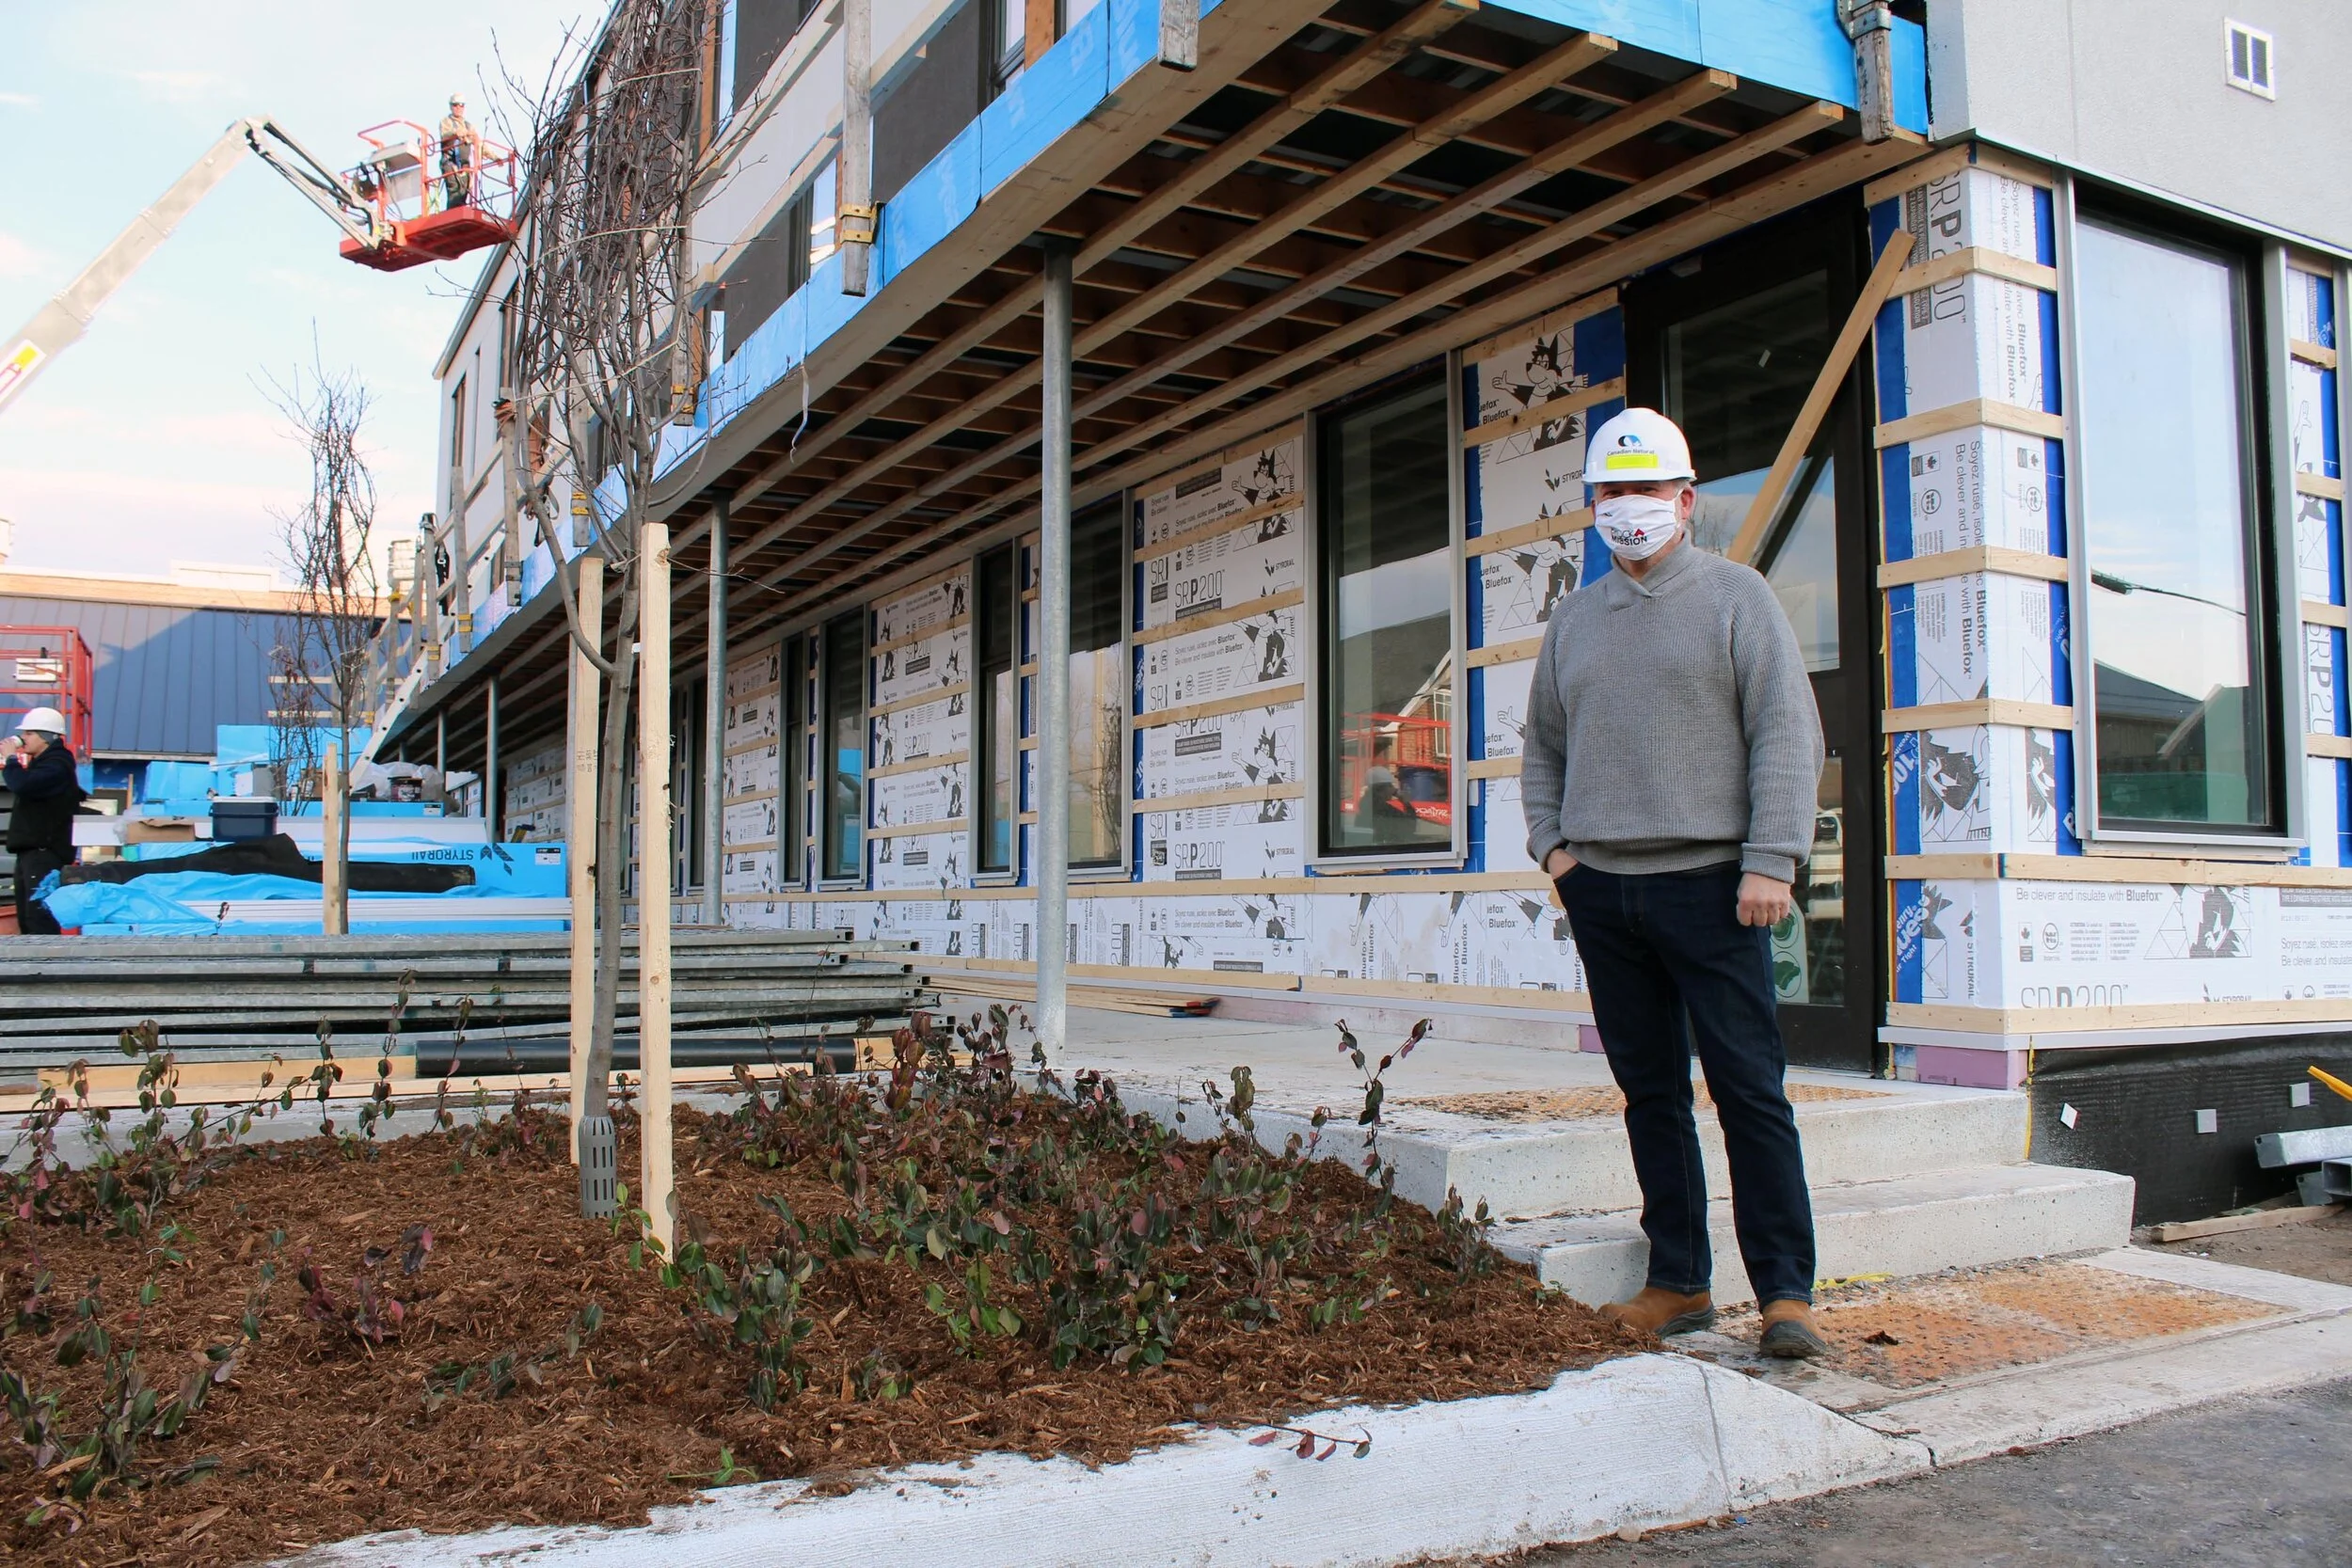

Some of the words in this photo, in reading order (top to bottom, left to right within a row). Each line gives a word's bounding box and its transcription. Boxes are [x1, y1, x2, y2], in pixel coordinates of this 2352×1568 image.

[2001, 193, 2010, 231] clever
[2006, 344, 2015, 398] Bluefox
[1955, 443, 1966, 463] Be
[1562, 469, 1582, 483] STYROR
[1957, 466, 1967, 502] clever
[1217, 499, 1235, 512] Bluefox
[1958, 508, 1970, 531] and
[1612, 534, 1647, 546] MISSION
[1968, 440, 1980, 480] Soyez
[1976, 590, 1987, 647] Bluefox
[1486, 576, 1512, 589] Bluefox
[1961, 587, 1972, 614] with
[1217, 634, 1235, 644] Bluefox
[1225, 643, 1243, 654] Bluefox
[1962, 618, 1974, 674] Bluefox
[1487, 746, 1515, 757] Bluefox
[1217, 770, 1235, 781] Bluefox
[1225, 781, 1243, 789] Bluefox
[2016, 887, 2029, 901] Be
[2031, 888, 2056, 901] clever
[2058, 889, 2074, 901] and
[2075, 889, 2106, 901] insulate
[2108, 890, 2124, 901] with
[2126, 889, 2160, 902] Bluefox
[1217, 908, 1234, 916] Bluefox
[1225, 920, 1243, 928] Bluefox
[1488, 919, 1516, 928] Bluefox
[2281, 937, 2301, 953] Soyez
[2320, 938, 2338, 949] isolez
[1901, 945, 1917, 964] Tight
[2281, 956, 2291, 966] Be
[2293, 956, 2312, 966] clever
[2315, 956, 2327, 966] and
